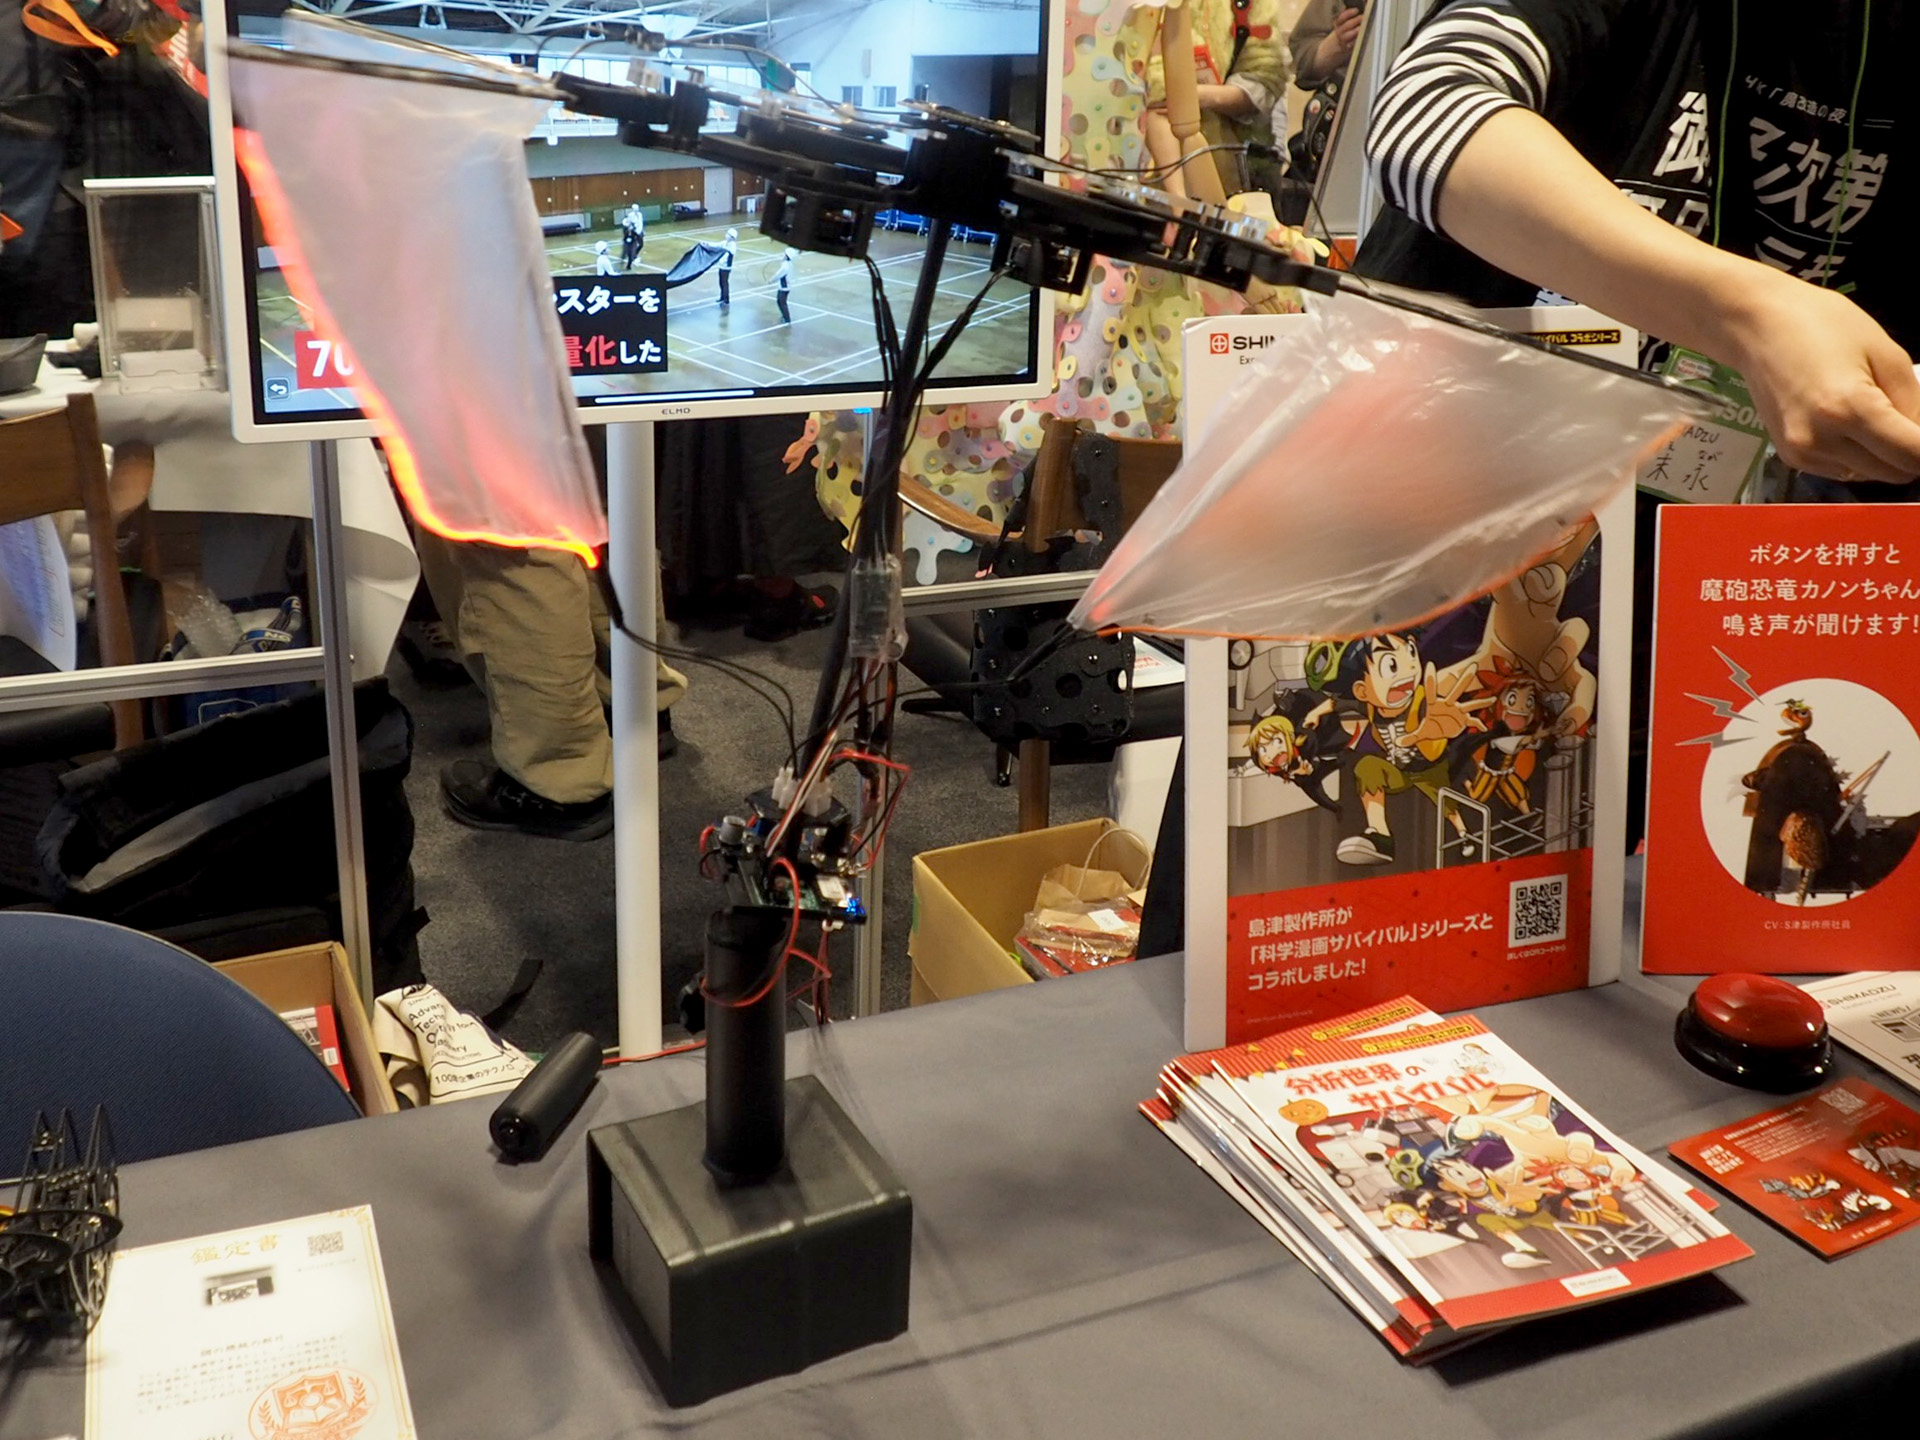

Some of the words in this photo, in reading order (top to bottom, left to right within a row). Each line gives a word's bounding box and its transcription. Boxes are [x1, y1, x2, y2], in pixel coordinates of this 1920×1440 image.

[552, 285, 661, 315] スターを
[1750, 542, 1900, 566] ボタンを押すと
[1700, 578, 1920, 601] 魔砲恐竜カノンちゃん
[1248, 906, 1353, 938] 島津製作所が
